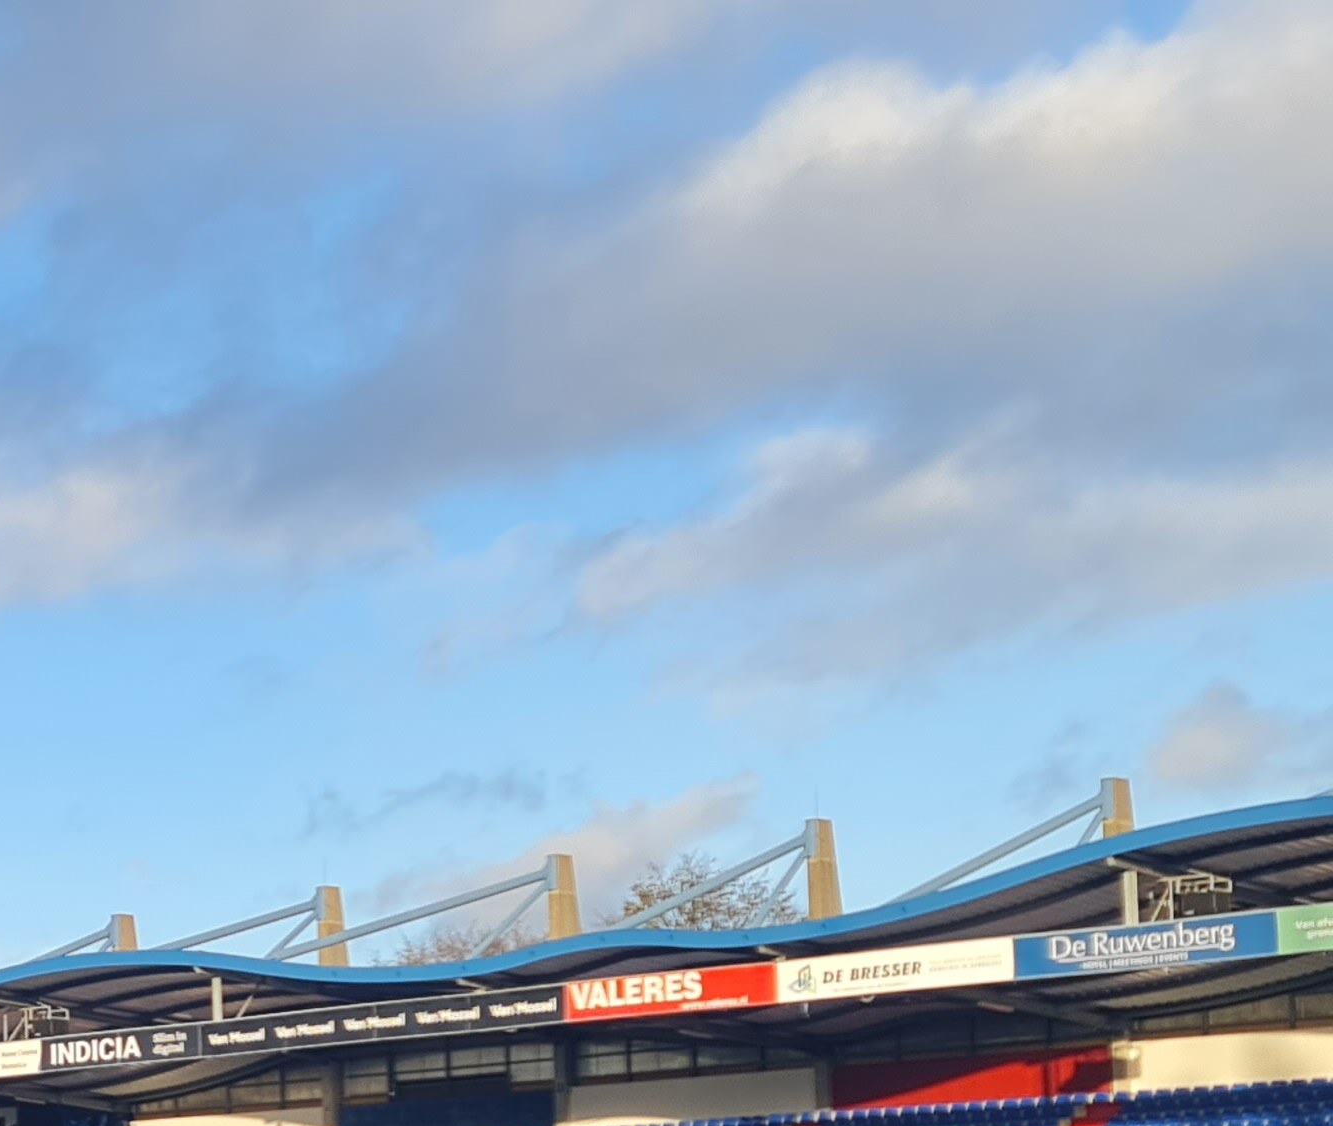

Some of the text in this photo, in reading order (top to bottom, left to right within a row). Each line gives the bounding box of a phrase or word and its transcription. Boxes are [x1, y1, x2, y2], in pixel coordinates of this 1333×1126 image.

[1050, 922, 1235, 959] De Ruwenberg
[823, 970, 843, 984] DE
[850, 961, 922, 982] BRESSER
[570, 971, 703, 1010] VALERES
[50, 1035, 141, 1065] INDICIA
